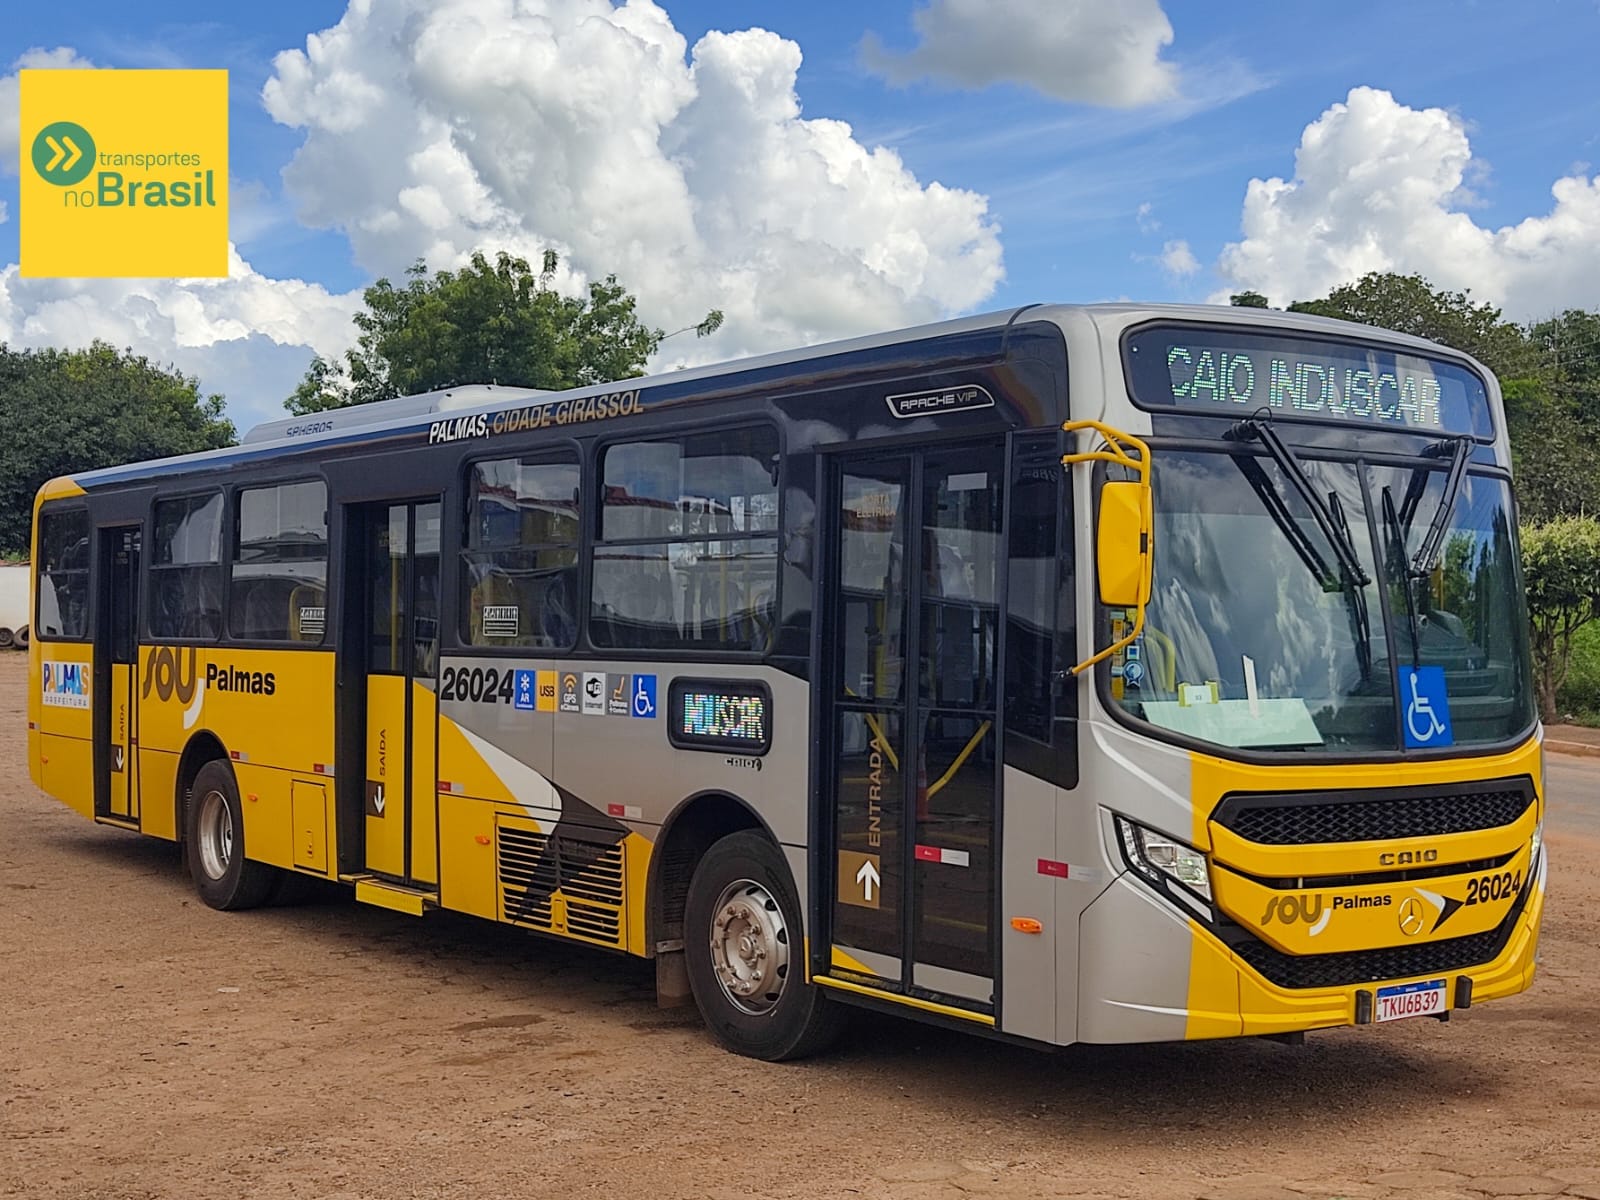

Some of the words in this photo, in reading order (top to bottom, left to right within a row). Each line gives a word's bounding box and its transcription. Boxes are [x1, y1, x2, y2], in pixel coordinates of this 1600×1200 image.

[900, 394, 956, 411] APACHE
[956, 390, 978, 402] VIP
[1167, 346, 1254, 404] CAIO
[1269, 358, 1441, 425] INDUSCAR
[286, 421, 334, 438] SPHEROS
[429, 413, 490, 444] PALMAS,
[493, 404, 551, 434] CIDADE
[555, 389, 645, 425] GIRASSOL
[43, 662, 90, 697] PALMAS
[206, 663, 276, 696] Palmas
[440, 667, 515, 704] 26024
[540, 685, 555, 697] USB
[868, 738, 882, 847] ENTRADA
[1379, 849, 1438, 866] CAIO
[1332, 894, 1393, 910] Palmas
[1464, 869, 1522, 906] 26024
[1382, 991, 1440, 1017] TKU6B39
